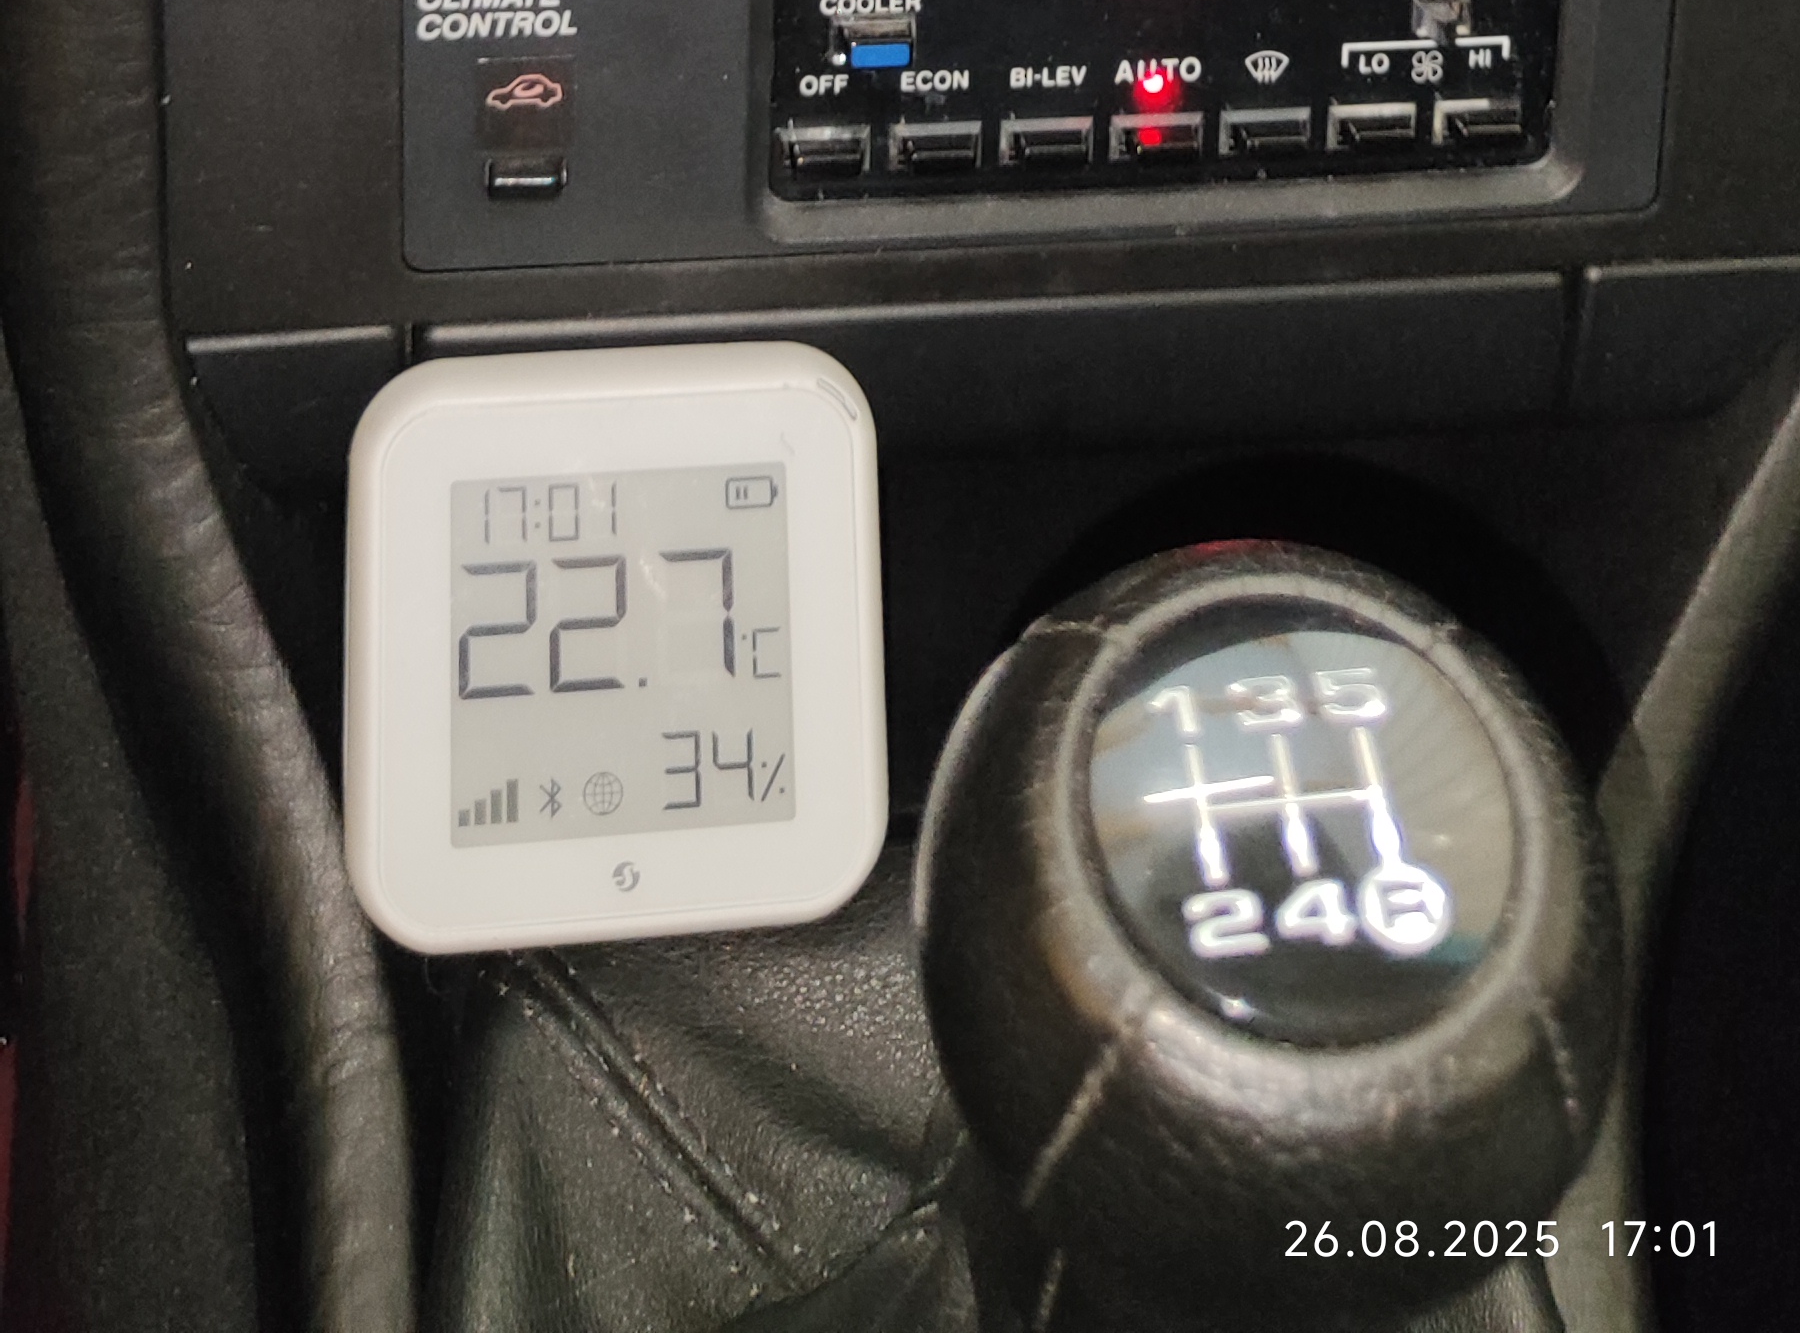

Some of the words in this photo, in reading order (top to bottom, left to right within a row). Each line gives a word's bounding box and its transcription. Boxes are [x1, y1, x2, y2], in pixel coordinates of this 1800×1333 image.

[416, 10, 579, 40] CONTROL
[1008, 65, 1088, 89] BI-LEV
[1114, 56, 1202, 83] AUTO
[1358, 52, 1391, 75] LO
[1468, 47, 1493, 70] HI
[799, 74, 849, 97] OFF
[899, 69, 970, 91] ECON
[483, 481, 618, 545] 17:01
[457, 547, 736, 701] 22.7
[1146, 684, 1200, 735] 1
[1227, 674, 1304, 728] 3
[1313, 667, 1388, 721] 5
[1181, 887, 1272, 960] 2
[1275, 877, 1358, 946] 4
